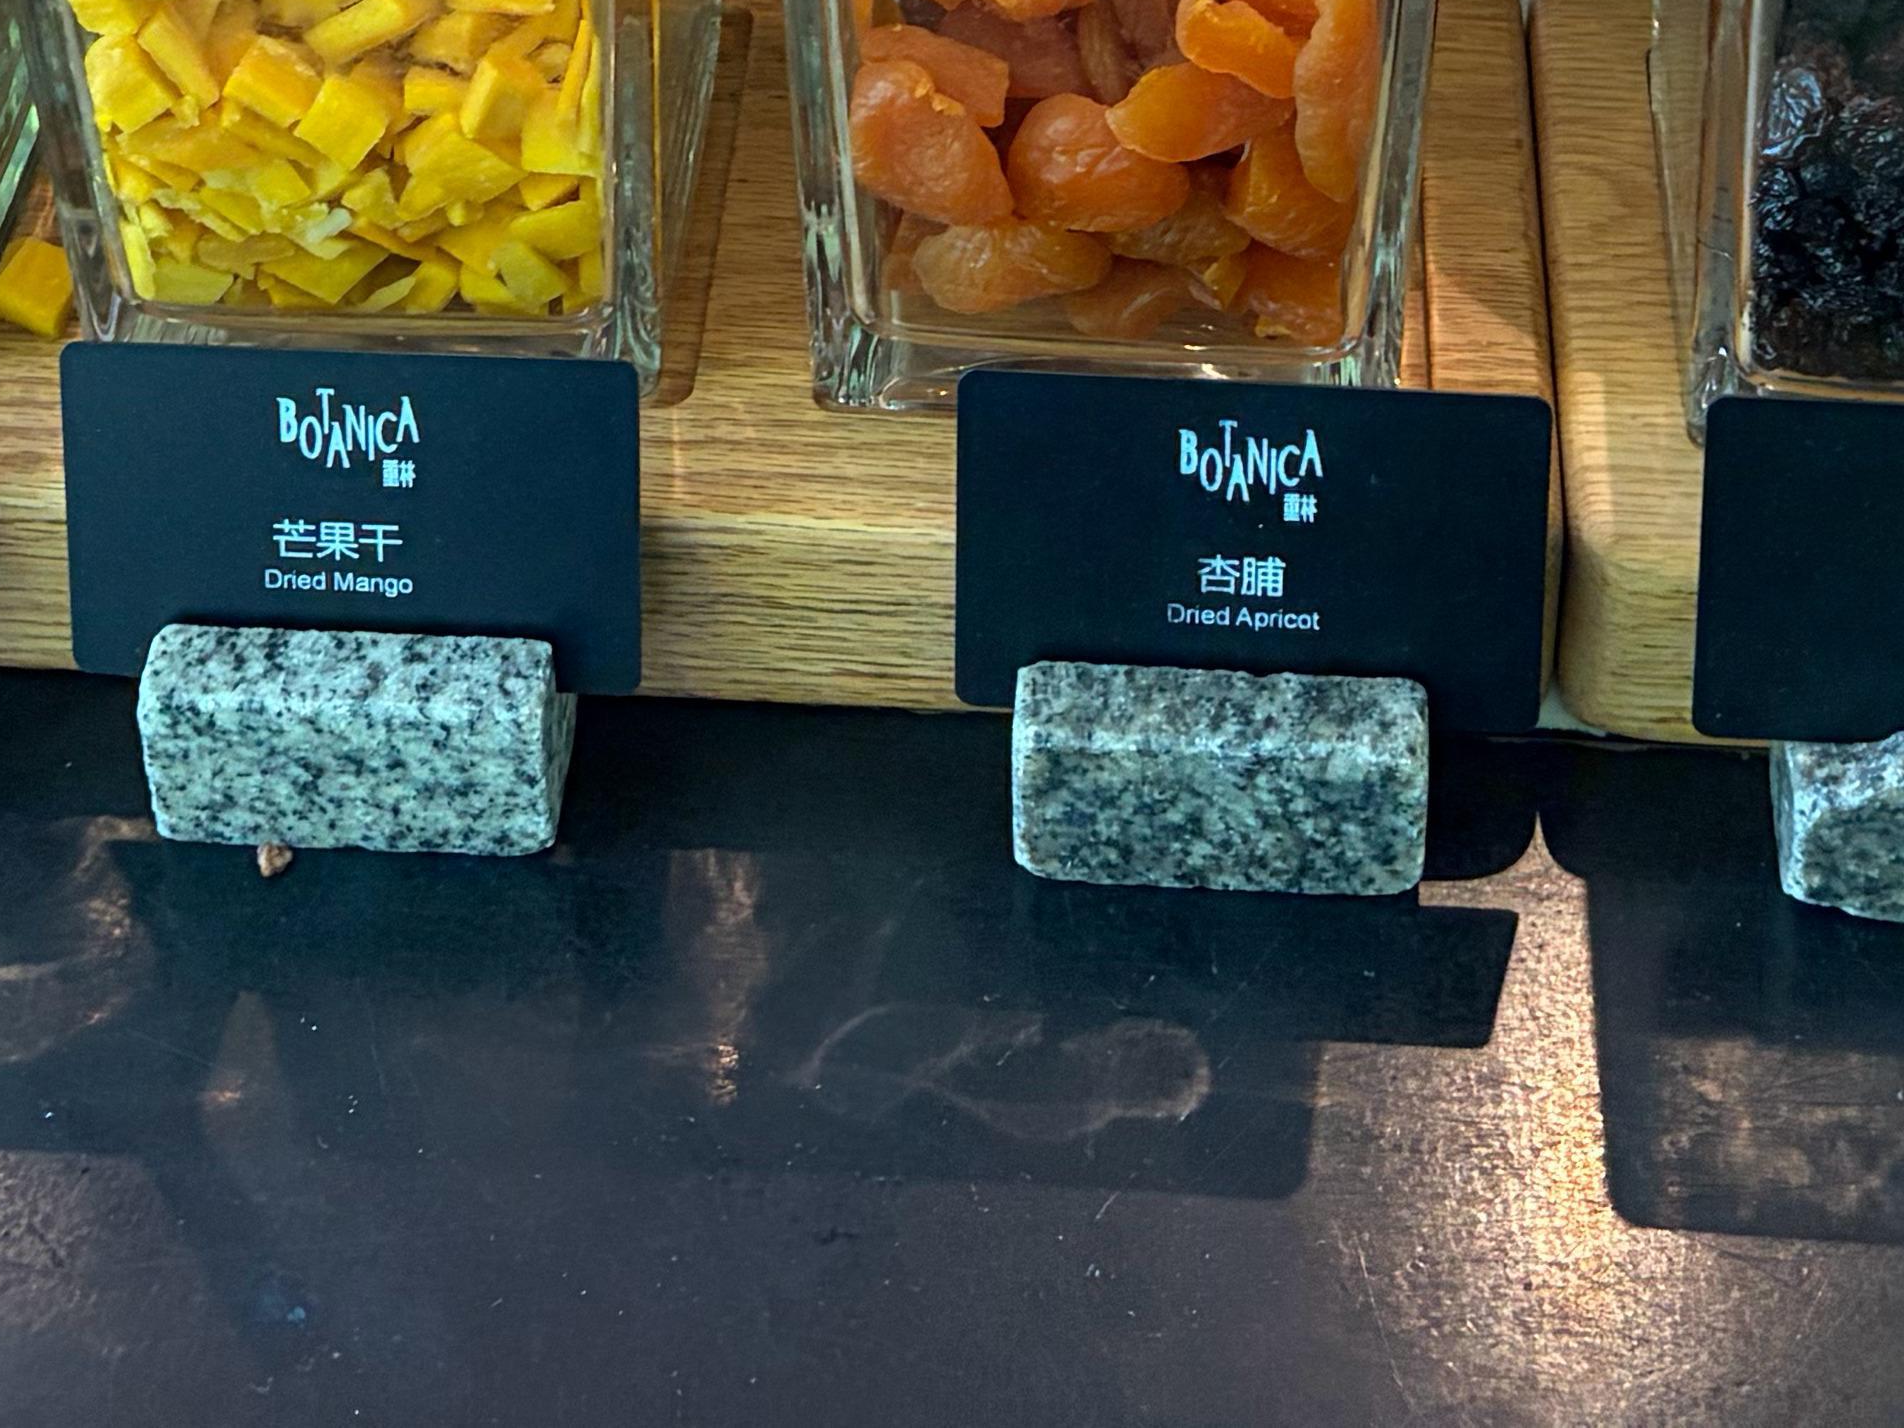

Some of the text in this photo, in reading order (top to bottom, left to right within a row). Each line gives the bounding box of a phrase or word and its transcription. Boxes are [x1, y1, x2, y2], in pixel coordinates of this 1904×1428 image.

[276, 388, 420, 469] BOTANICA
[1178, 419, 1323, 502] BOTANICA
[273, 519, 403, 562] 芒果干
[264, 569, 413, 597] Dried Mango
[1197, 554, 1286, 597] 杏脯
[1167, 603, 1320, 632] Dried Apricot
